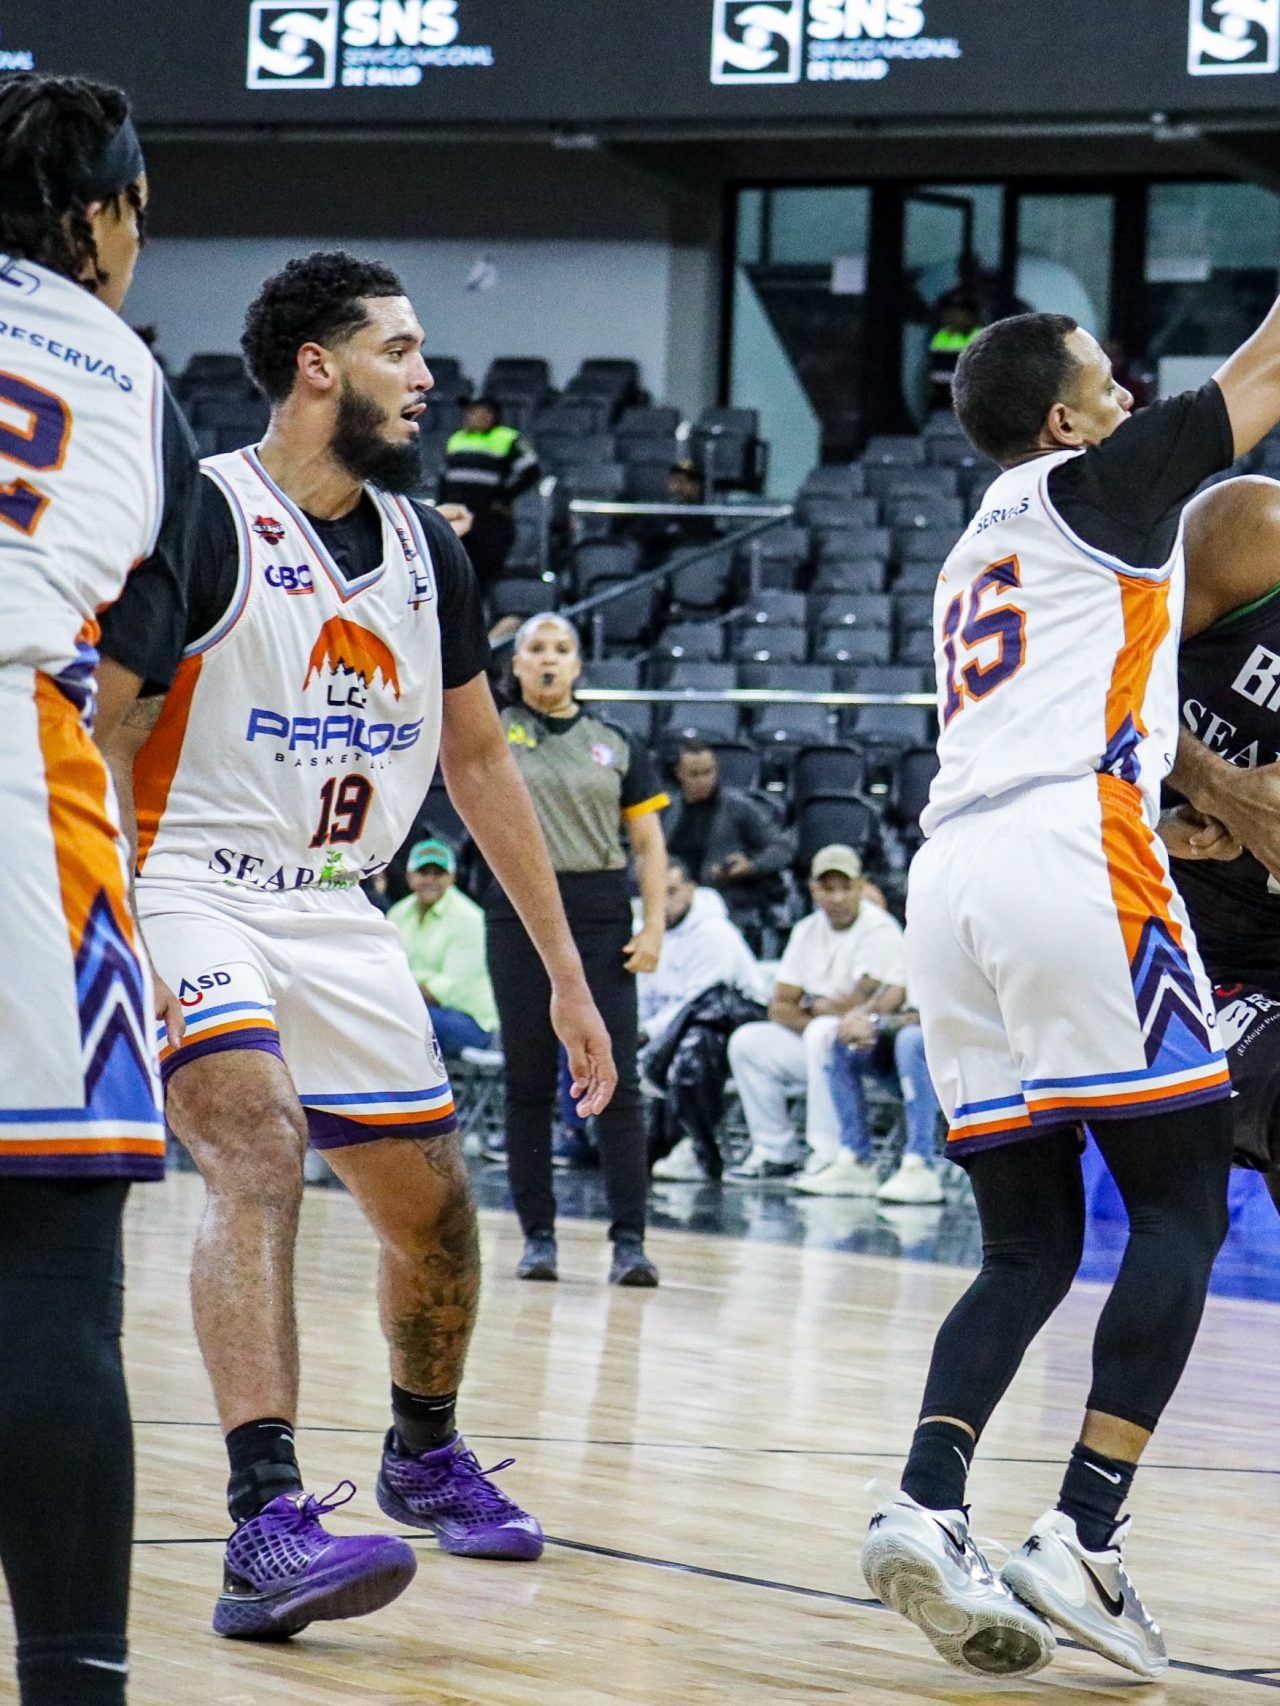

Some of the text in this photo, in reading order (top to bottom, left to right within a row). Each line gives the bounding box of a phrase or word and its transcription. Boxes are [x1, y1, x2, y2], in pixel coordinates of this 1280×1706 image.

[342, 0, 458, 46] SNS
[807, 0, 925, 39] SNS
[942, 553, 1027, 732] 15
[309, 773, 374, 849] 19
